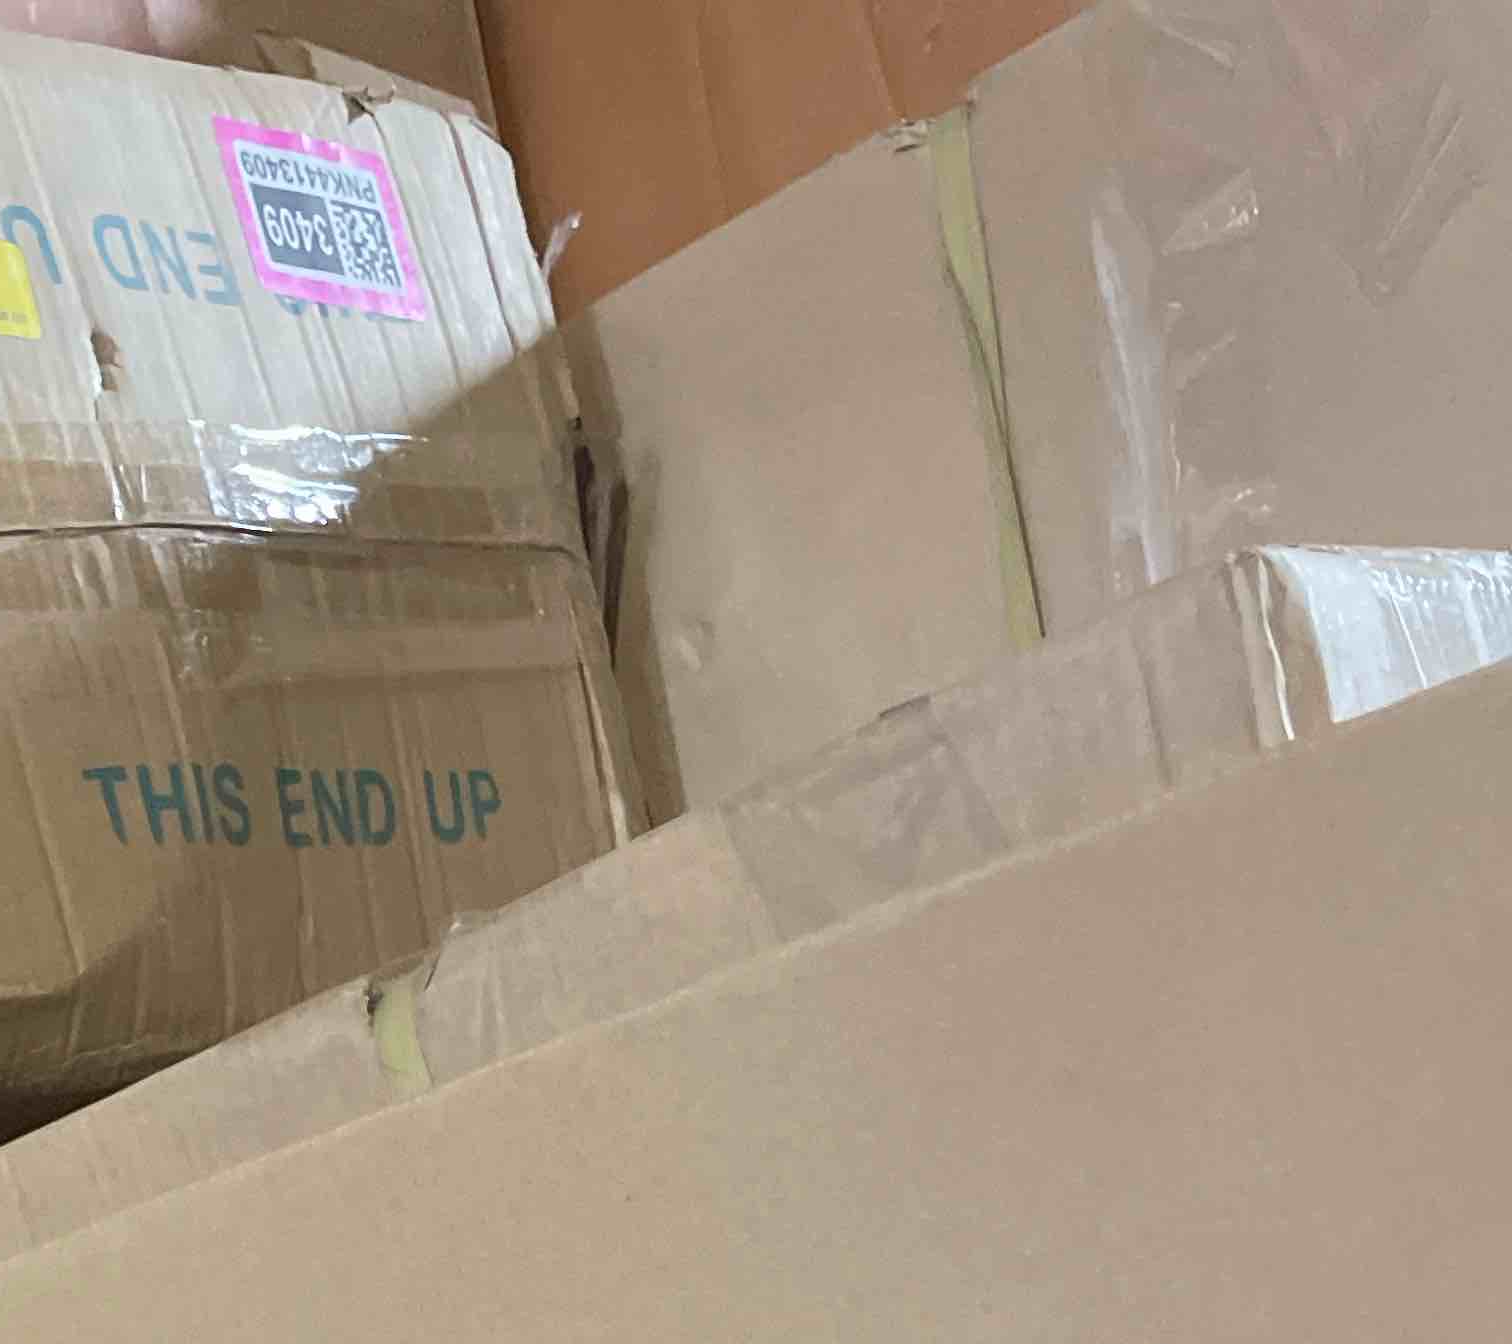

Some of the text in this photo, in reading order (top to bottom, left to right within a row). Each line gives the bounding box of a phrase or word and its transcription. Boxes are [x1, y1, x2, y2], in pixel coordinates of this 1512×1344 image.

[92, 213, 242, 306] END
[264, 201, 335, 258] 3409
[82, 761, 502, 848] THIS END UP
